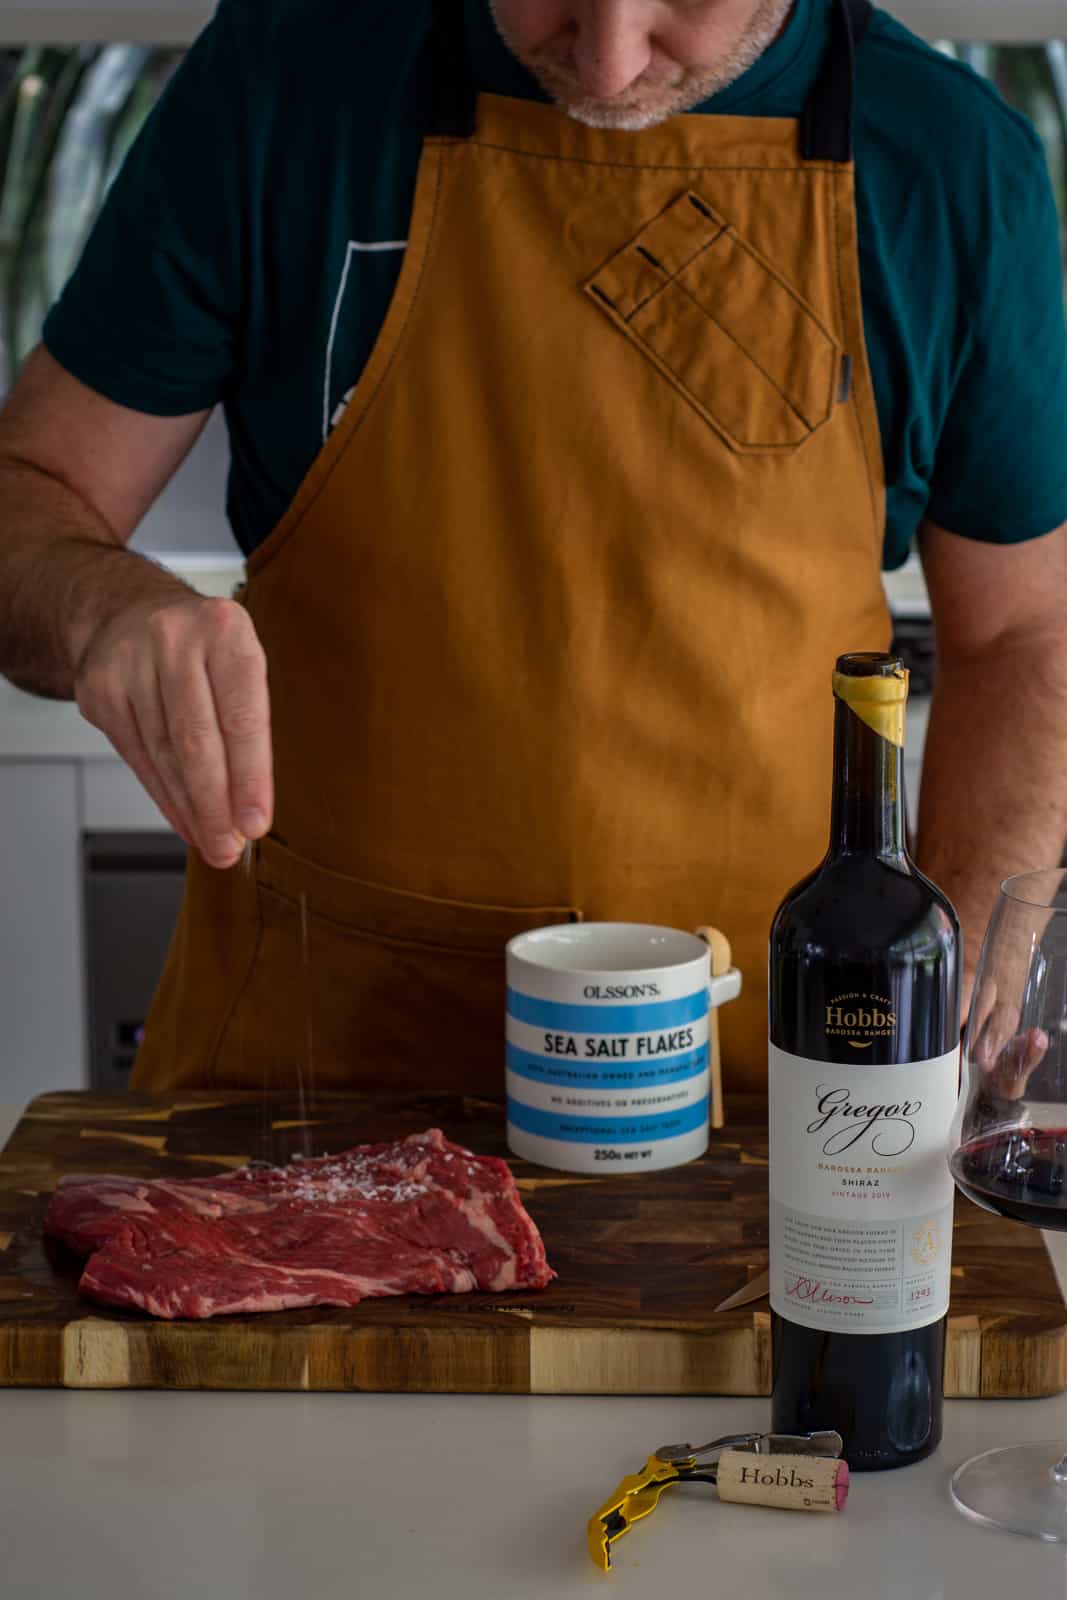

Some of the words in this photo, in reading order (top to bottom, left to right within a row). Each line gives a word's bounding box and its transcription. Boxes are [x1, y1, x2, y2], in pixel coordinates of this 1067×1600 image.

[825, 1006, 897, 1027] Hobbs
[544, 1033, 578, 1056] SEA
[584, 1038, 629, 1057] SALT
[637, 1028, 694, 1055] FLAKES
[806, 1083, 922, 1157] Gregor
[818, 1163, 862, 1174] BAROSSA
[841, 1179, 880, 1187] SHIRAZ
[831, 1190, 867, 1199] VINTAGE
[740, 1467, 815, 1489] Hobbs
